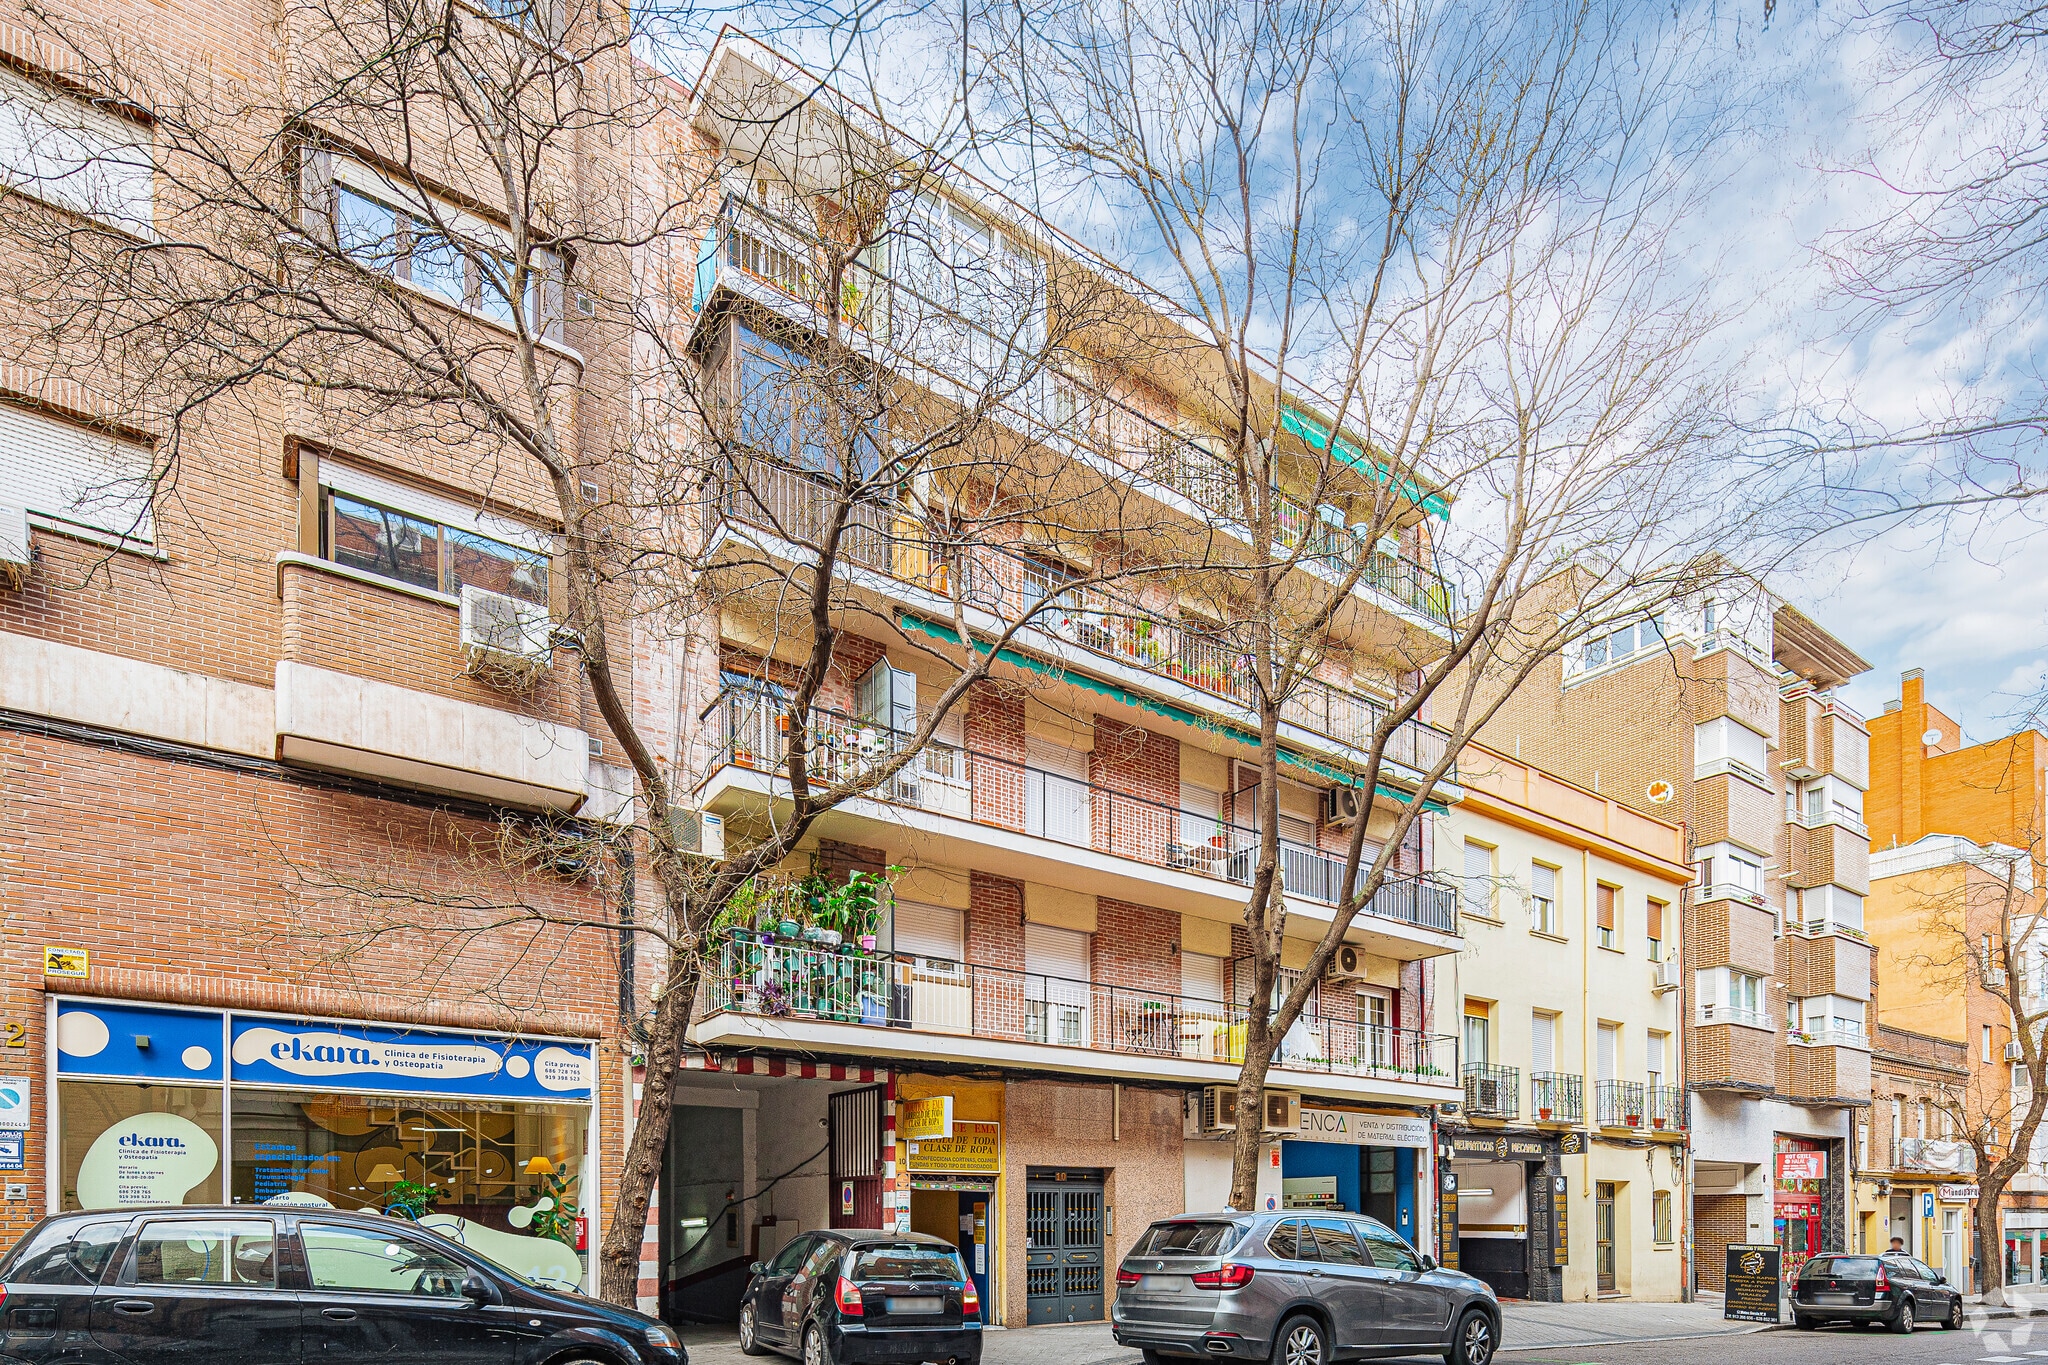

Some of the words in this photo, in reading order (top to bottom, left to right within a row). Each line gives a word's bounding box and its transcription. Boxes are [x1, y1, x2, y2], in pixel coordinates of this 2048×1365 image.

[5, 1022, 26, 1047] 2
[419, 1051, 430, 1060] de
[432, 1053, 486, 1064] Fisioterapia
[384, 1060, 390, 1068] y
[974, 1123, 996, 1134] EMA
[1359, 1121, 1379, 1129] VENTA
[956, 1136, 968, 1145] DE
[973, 1137, 996, 1146] TODA
[1357, 1131, 1366, 1139] DE
[1367, 1132, 1396, 1141] MATERIAL
[254, 1142, 297, 1151] Estamos
[923, 1143, 952, 1152] CLASE
[955, 1144, 967, 1153] DE
[970, 1145, 993, 1154] ROPA
[254, 1153, 325, 1162] especializados
[1055, 1172, 1067, 1181] 10
[1925, 1195, 1932, 1215] P
